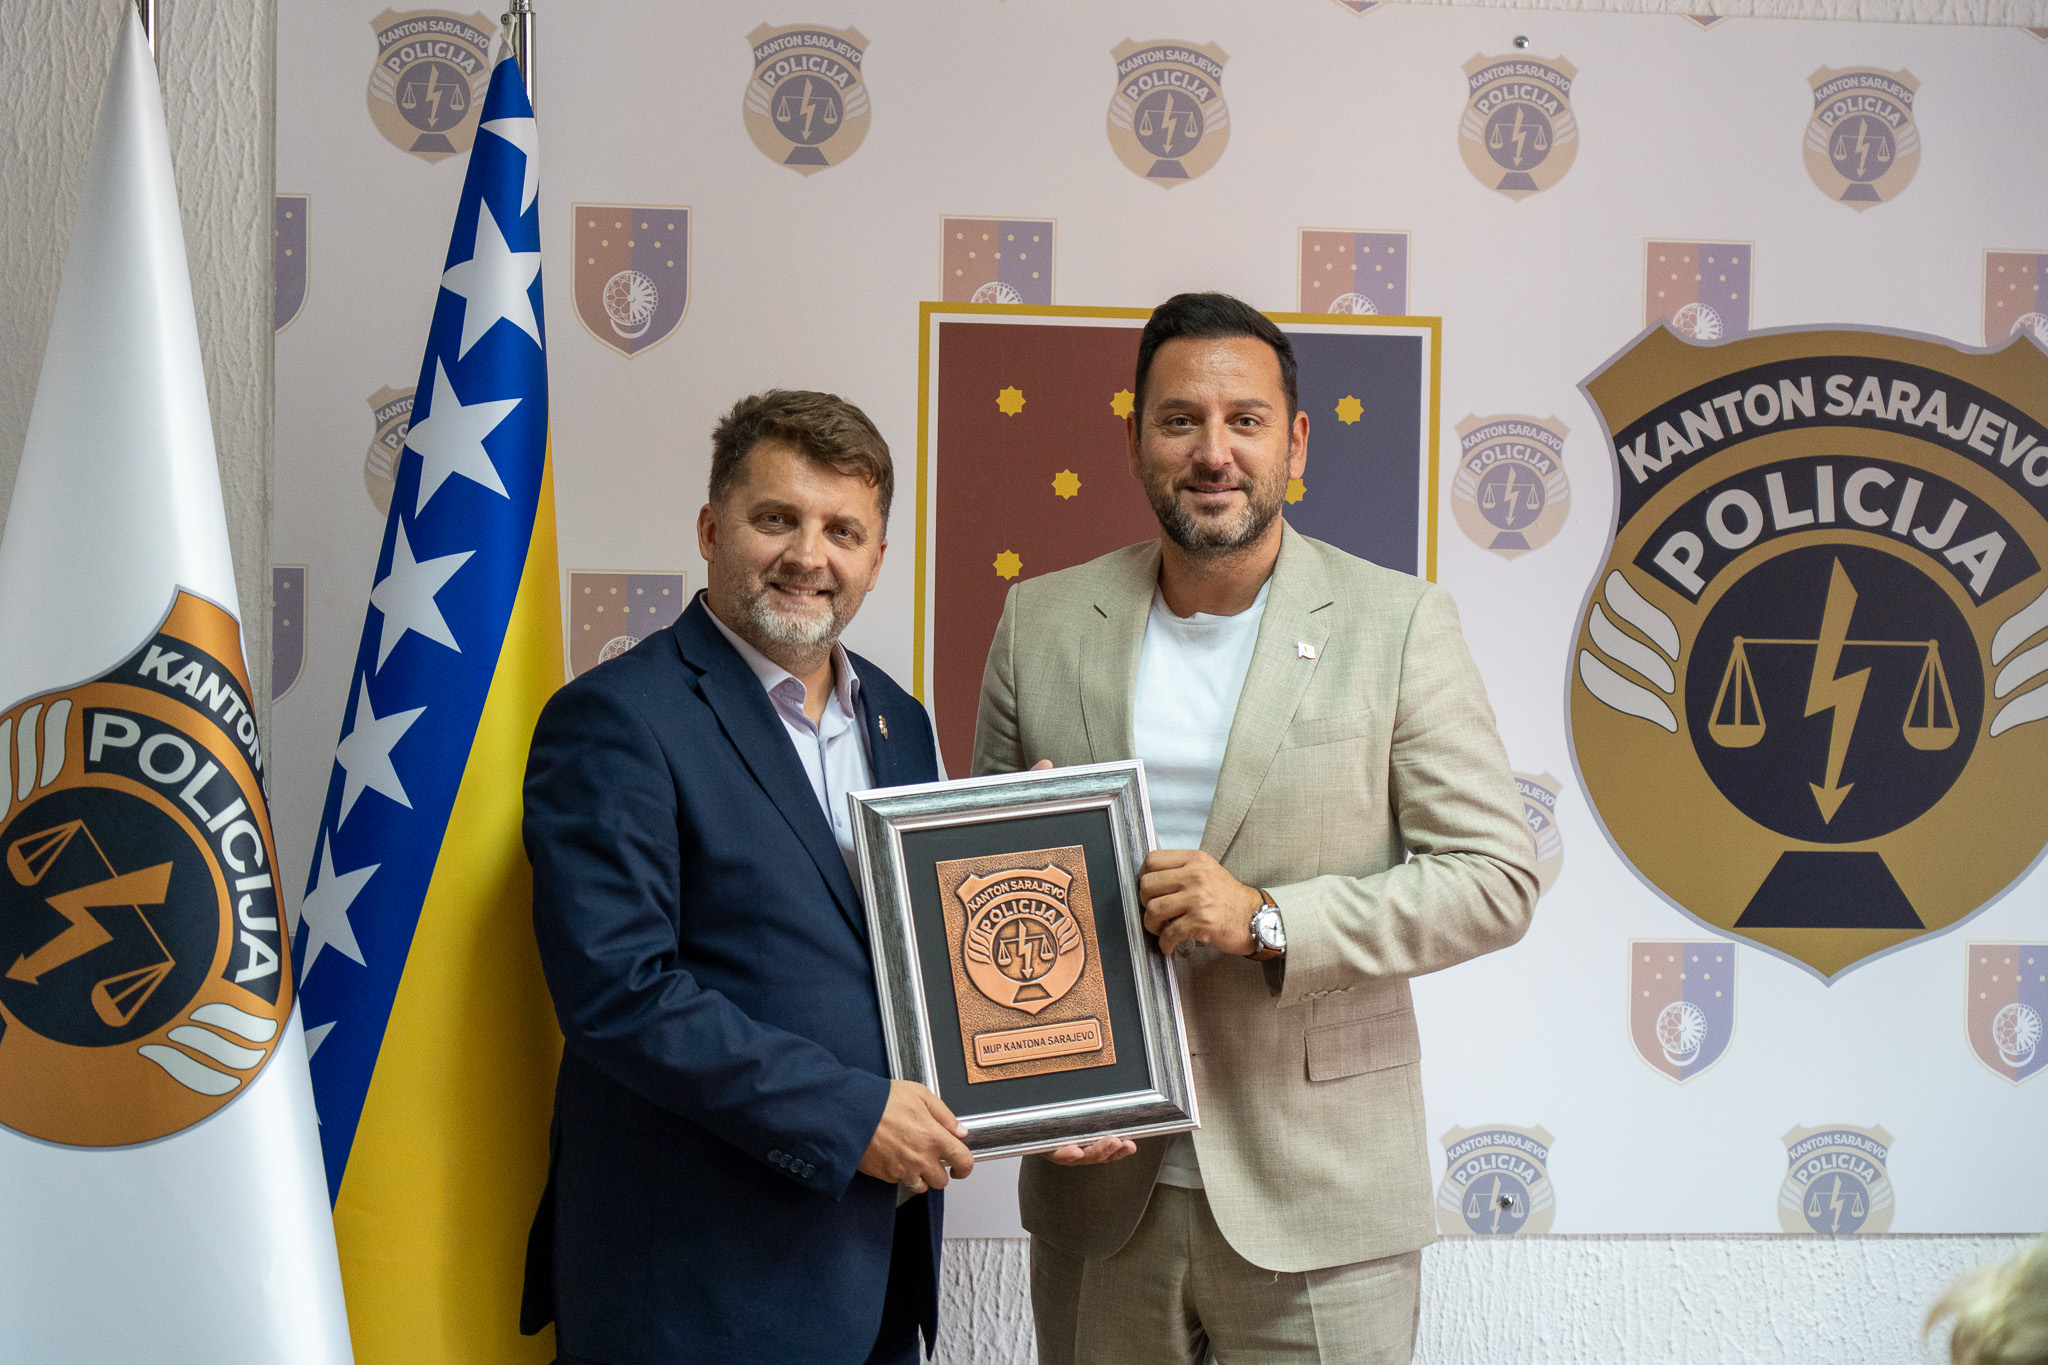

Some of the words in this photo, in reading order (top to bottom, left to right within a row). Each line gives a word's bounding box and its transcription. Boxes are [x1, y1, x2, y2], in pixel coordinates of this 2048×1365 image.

[379, 21, 427, 46] KANTON
[429, 20, 489, 49] SARAJEVO
[755, 35, 801, 59] KANTON
[804, 35, 861, 62] SARAJEVO
[387, 42, 476, 74] POLICIJA
[763, 56, 849, 88] POLICIJA
[1119, 50, 1164, 74] KANTON
[1166, 50, 1221, 77] SARAJEVO
[1127, 71, 1209, 102] POLICIJA
[1470, 65, 1514, 89] KANTON
[1516, 64, 1570, 91] SARAJEVO
[1815, 77, 1858, 100] KANTON
[1860, 76, 1914, 103] SARAJEVO
[1477, 84, 1558, 115] POLICIJA
[1822, 97, 1901, 127] POLICIJA
[376, 399, 414, 423] KANTO
[1463, 425, 1506, 449] KANTON
[1508, 424, 1562, 450] SARAJEVO
[1619, 376, 1815, 484] KANTON
[1824, 374, 2048, 487] SARAJEVO
[1470, 444, 1551, 475] POLICIJA
[1653, 465, 2007, 597] POLICIJA
[138, 645, 261, 771] KANTON
[1516, 782, 1555, 806] RAJEVO
[89, 713, 279, 984] POLICIJA
[968, 882, 1010, 911] KANTON
[1011, 880, 1065, 899] SARAJEVO
[980, 900, 1057, 934] POLICIJA
[982, 1043, 1002, 1055] MUP
[1004, 1037, 1046, 1051] KANTONA
[1048, 1031, 1094, 1046] SARAJEVO
[1448, 1135, 1491, 1160] KANTON
[1493, 1134, 1547, 1159] SARAJEVO
[1789, 1135, 1832, 1160] KANTON
[1834, 1134, 1886, 1159] SARAJEVO
[1455, 1154, 1535, 1184] POLICIJA
[1796, 1154, 1875, 1184] POLICIJA
